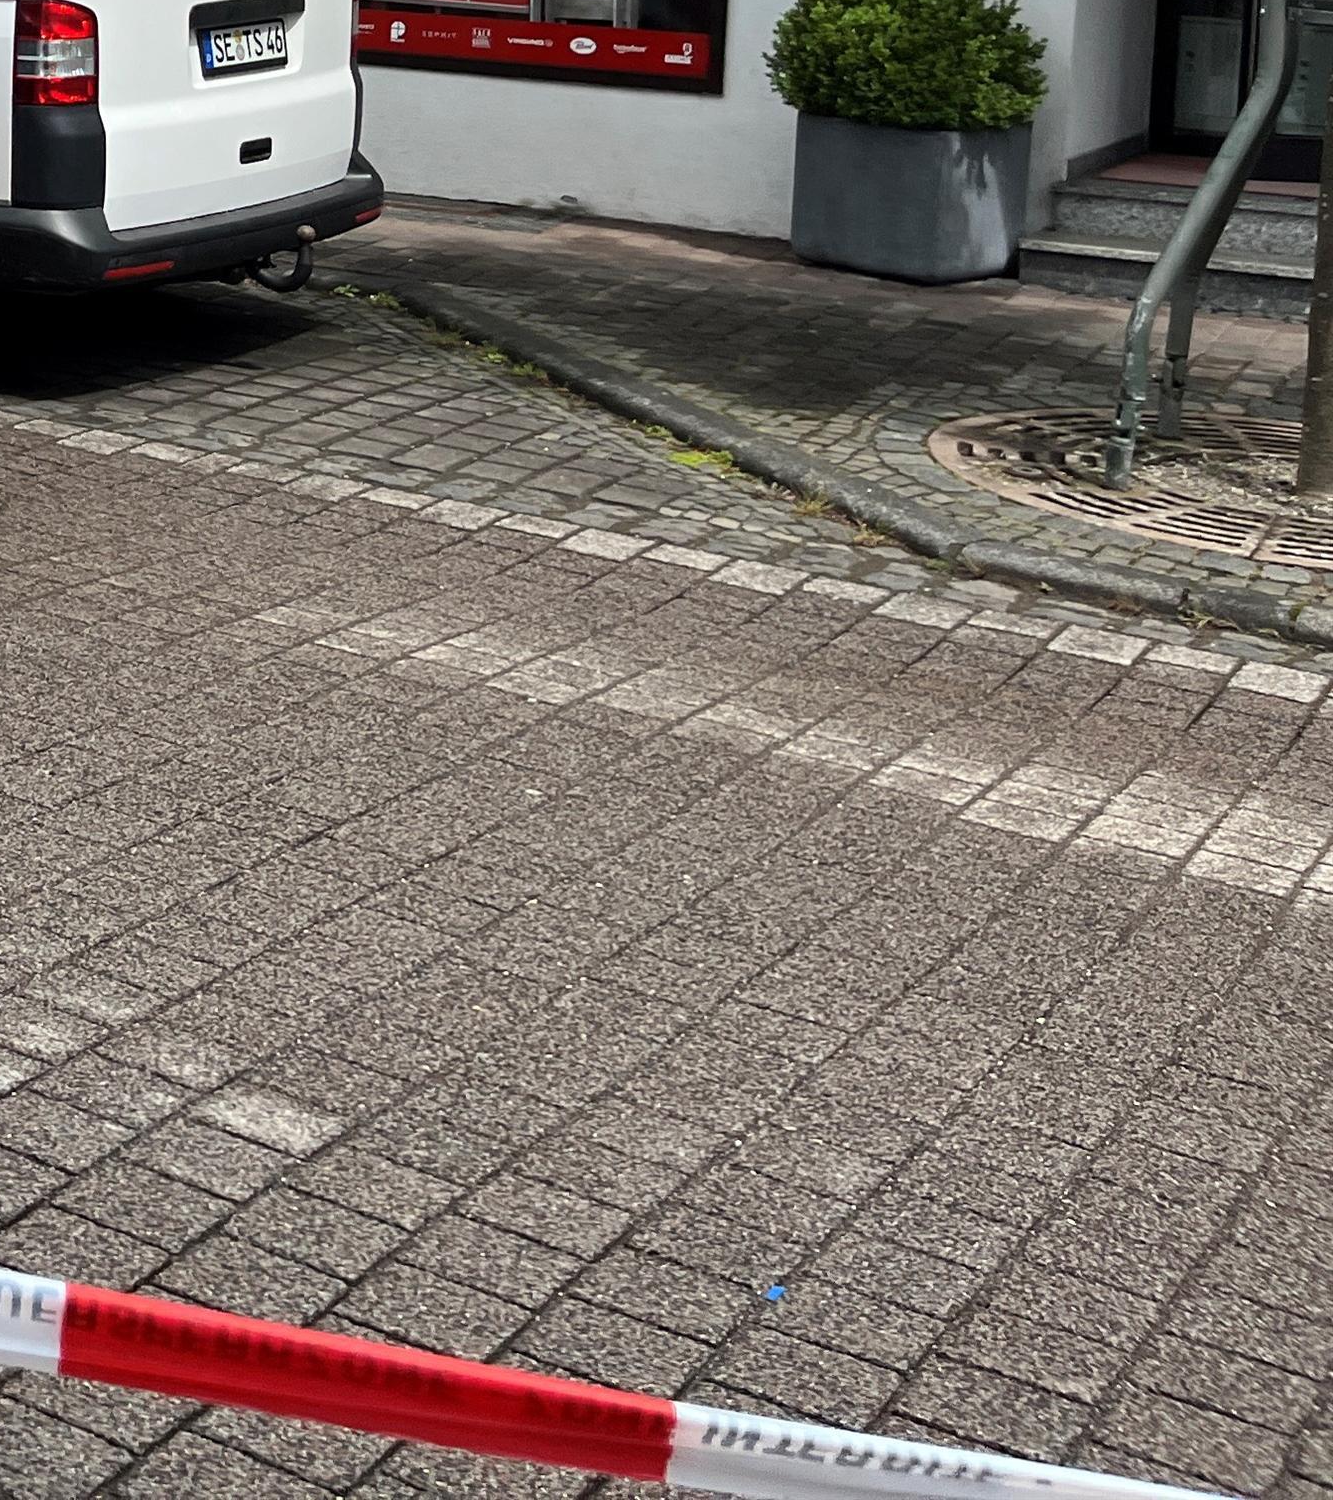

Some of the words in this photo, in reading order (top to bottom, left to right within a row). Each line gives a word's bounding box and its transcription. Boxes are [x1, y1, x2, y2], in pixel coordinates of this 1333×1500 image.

[214, 33, 236, 63] SE
[242, 28, 264, 57] TS
[267, 25, 283, 55] 46
